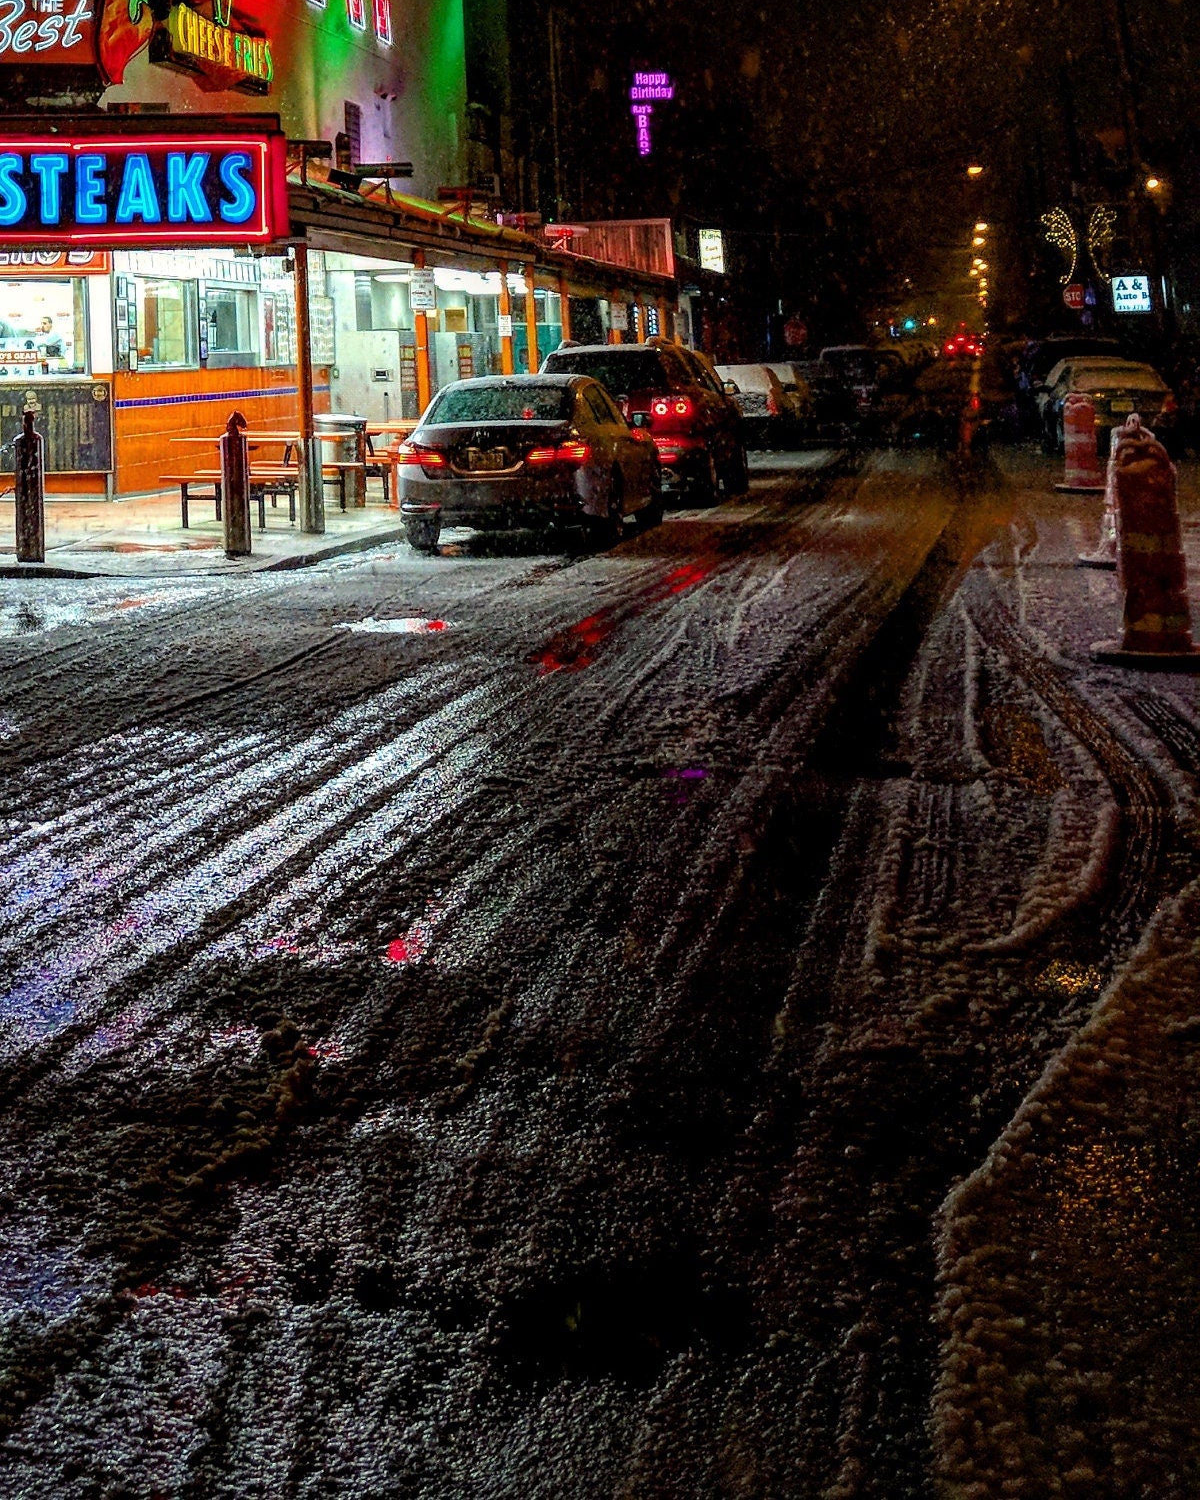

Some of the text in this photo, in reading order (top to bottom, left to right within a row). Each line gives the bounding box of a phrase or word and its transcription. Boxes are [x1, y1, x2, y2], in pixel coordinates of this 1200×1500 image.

[178, 2, 274, 83] CHEESE FRIES
[635, 72, 667, 86] Happy
[631, 86, 672, 99] Birthday
[1115, 279, 1129, 291] A
[1116, 292, 1138, 301] Auto
[13, 351, 37, 360] GEAR
